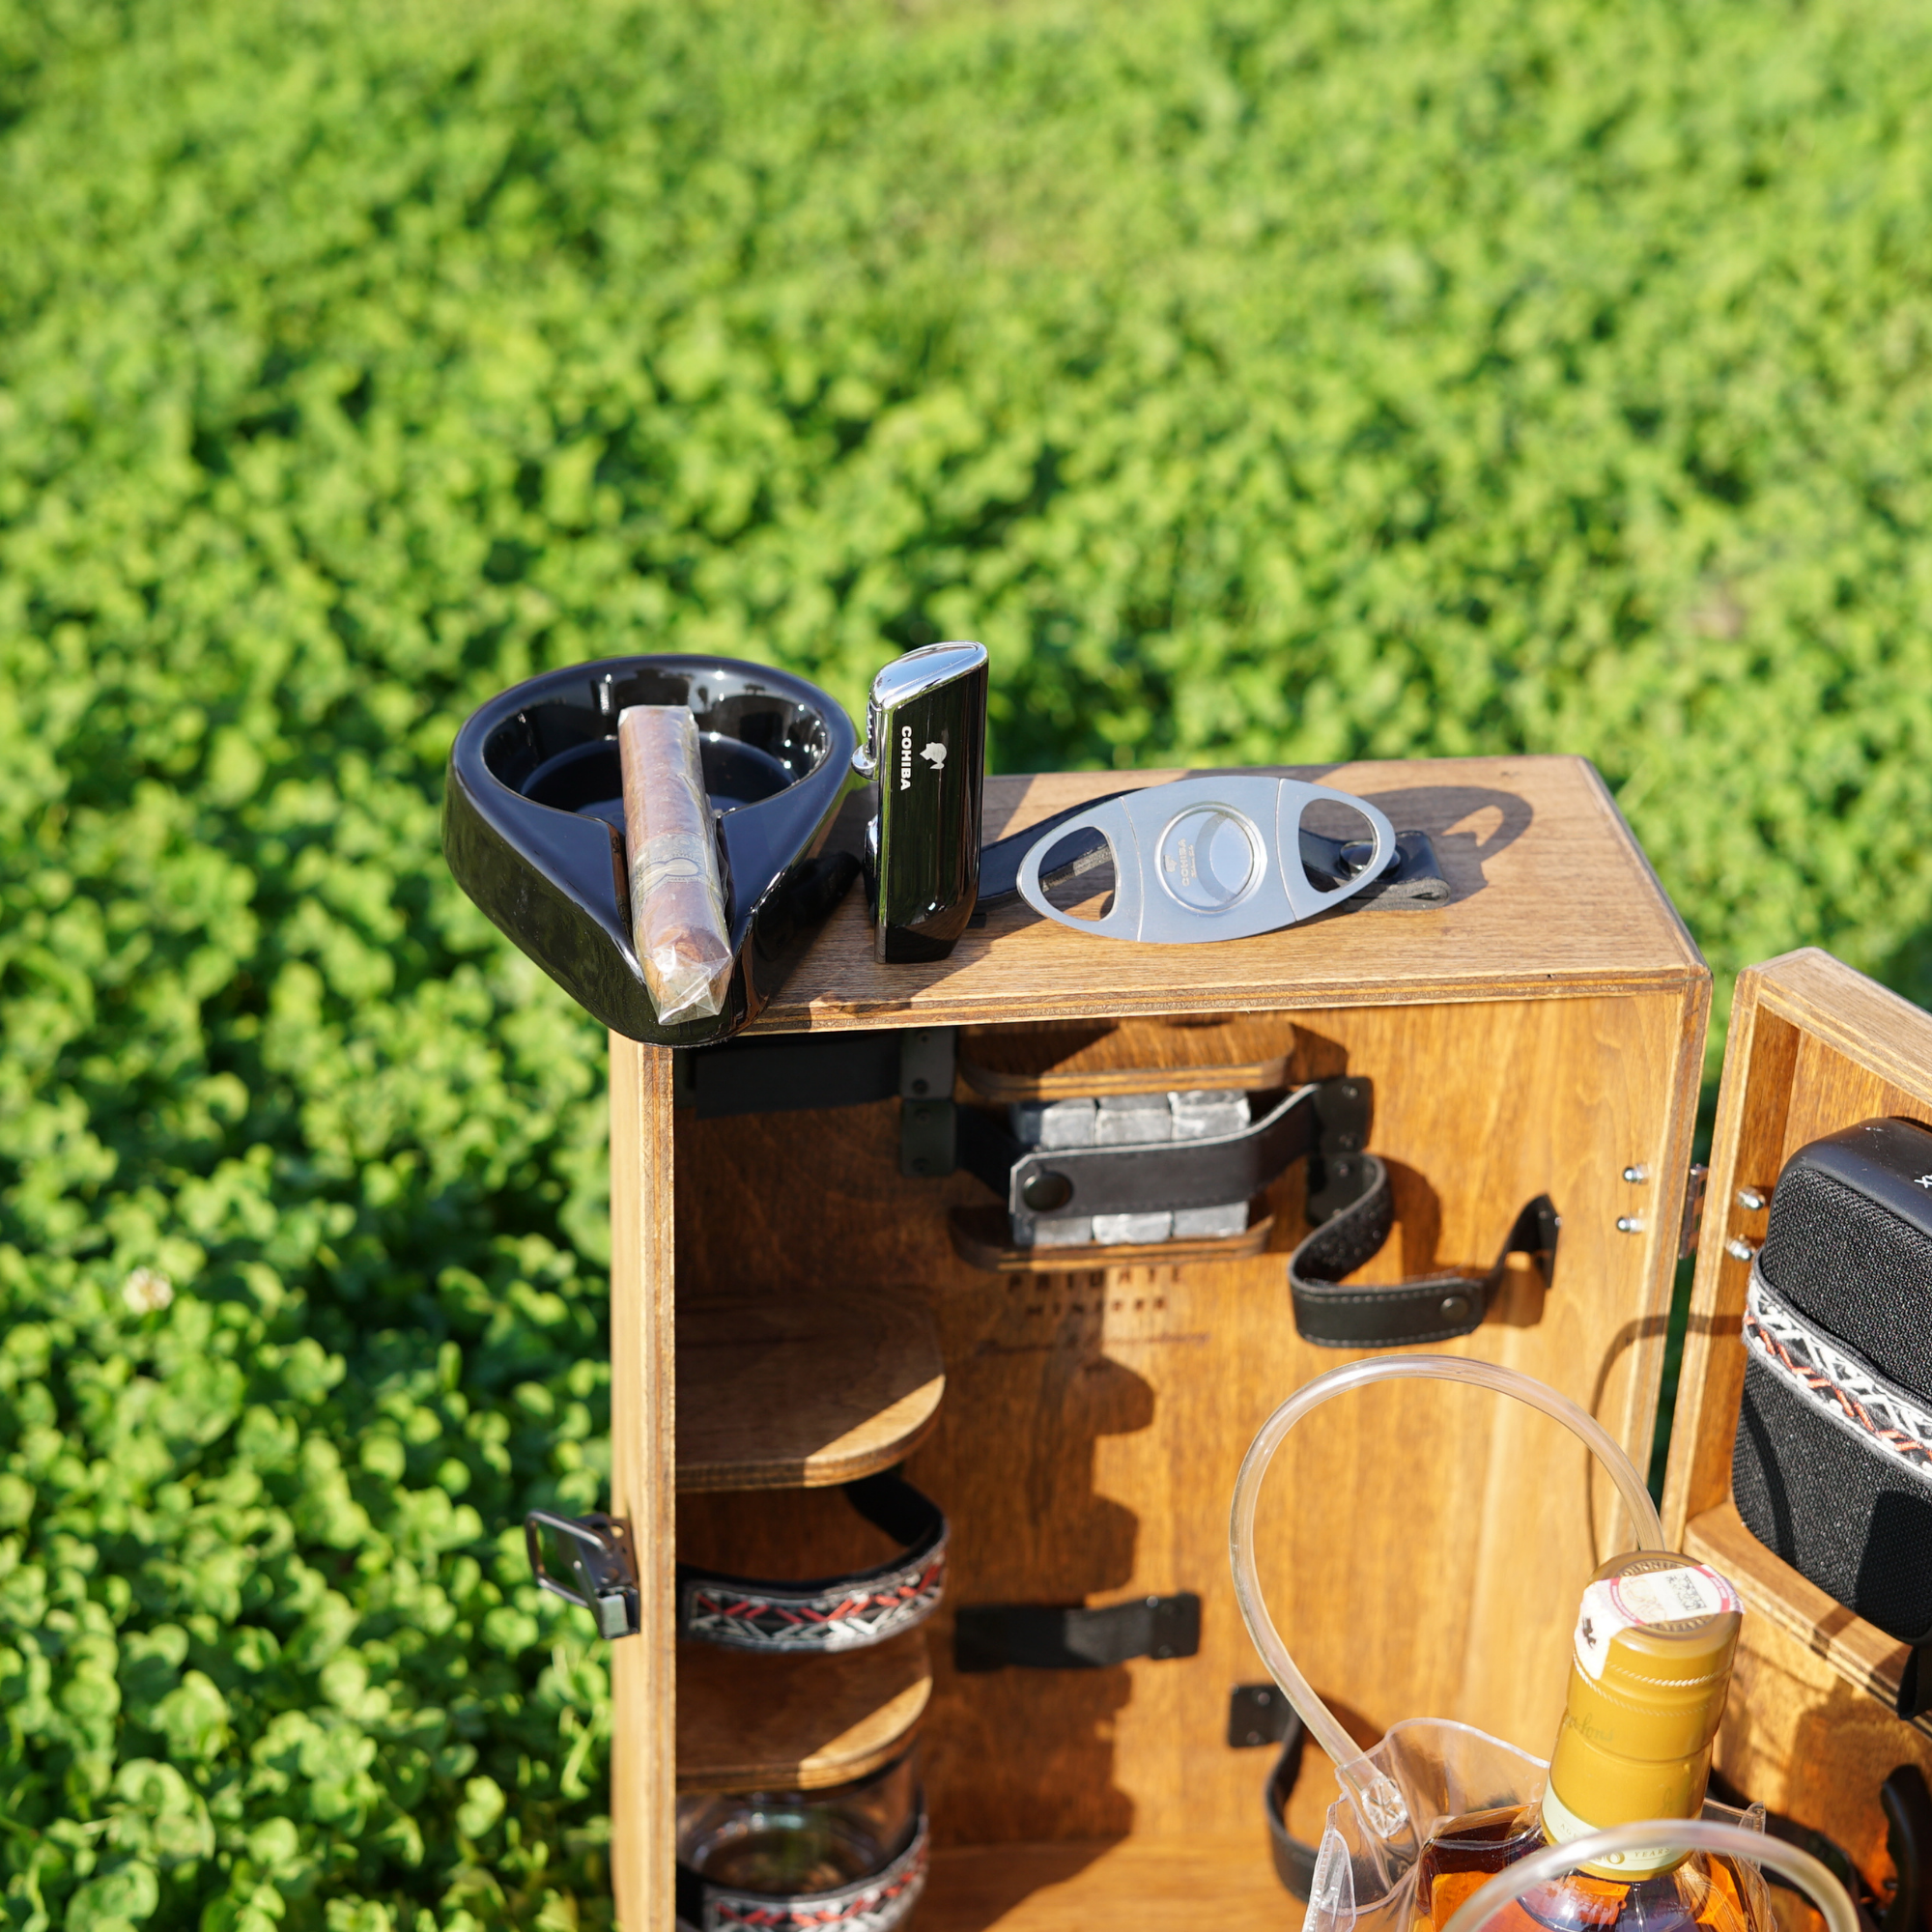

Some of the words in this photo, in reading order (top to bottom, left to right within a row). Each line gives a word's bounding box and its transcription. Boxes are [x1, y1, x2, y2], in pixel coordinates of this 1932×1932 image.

[900, 725, 912, 790] COHIBA
[1179, 838, 1190, 887] COHIBA
[1634, 1847, 1671, 1859] YEARS
